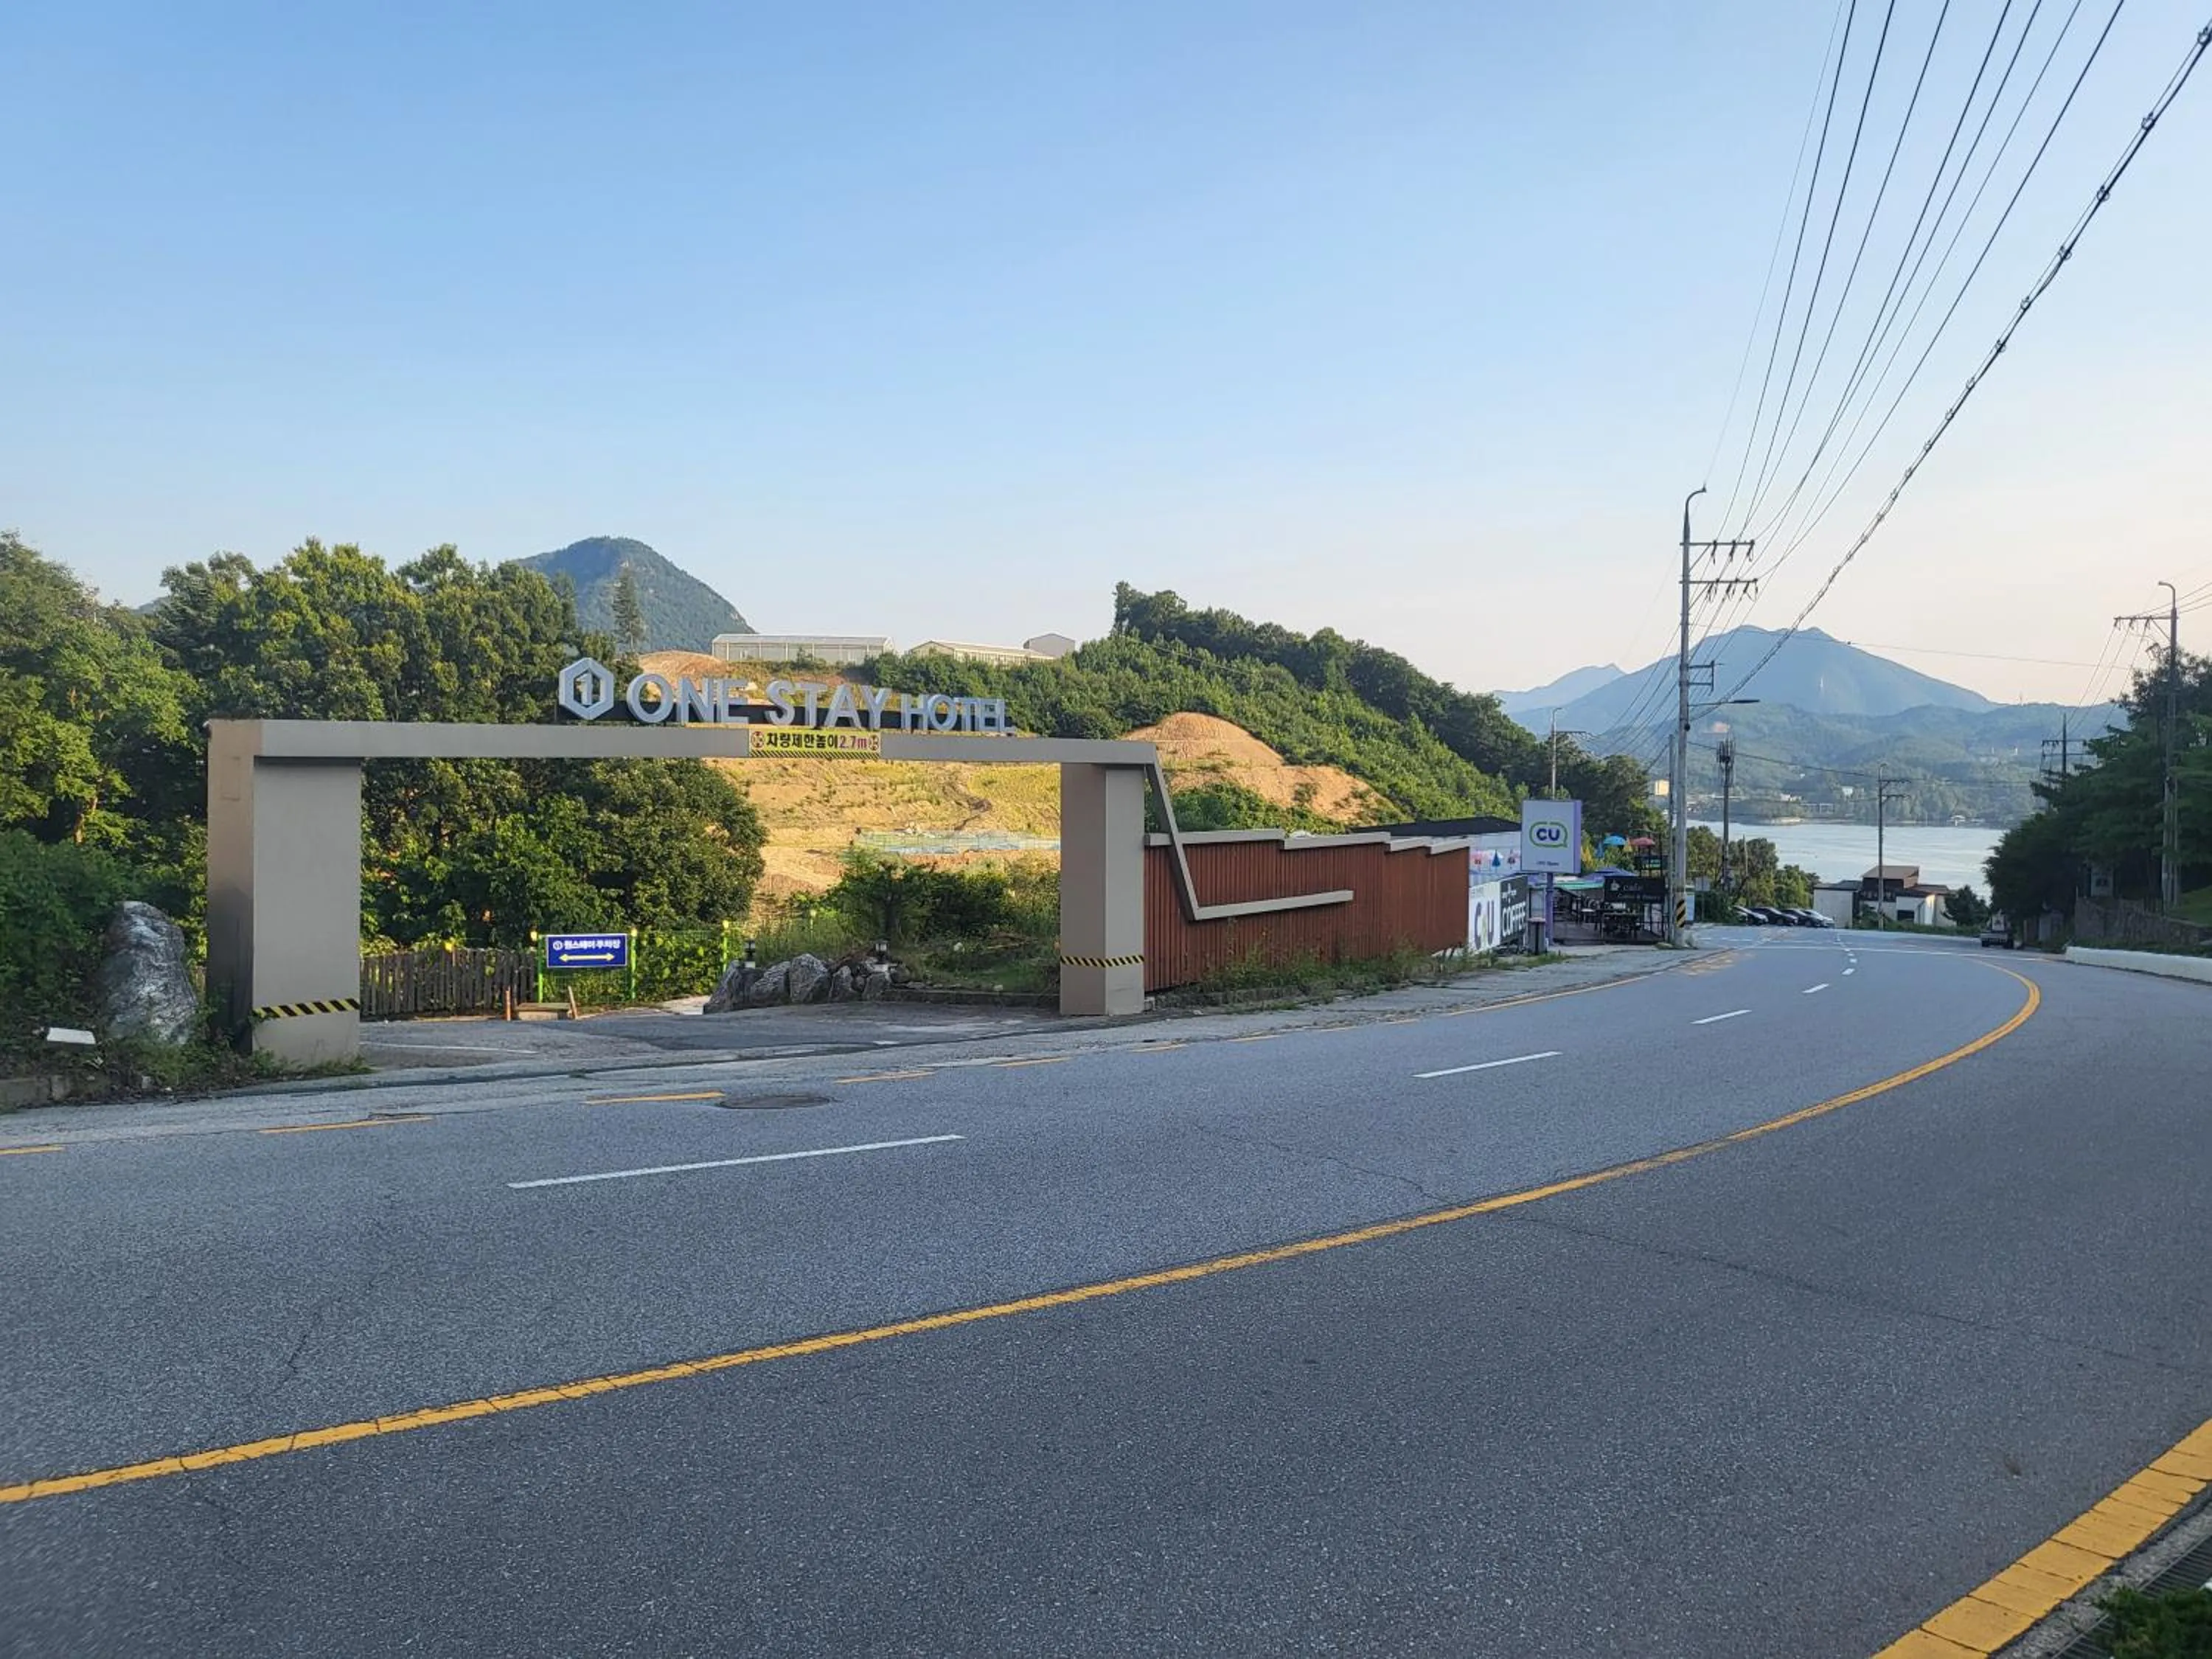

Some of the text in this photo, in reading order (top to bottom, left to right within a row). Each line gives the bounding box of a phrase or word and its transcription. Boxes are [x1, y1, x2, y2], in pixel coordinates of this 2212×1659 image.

[626, 673, 749, 725] ONE
[765, 680, 892, 729] STAY
[900, 693, 1016, 733] HOTEL
[1536, 828, 1560, 841] CU
[1474, 900, 1495, 950] CU
[1502, 901, 1526, 938] COFFEE
